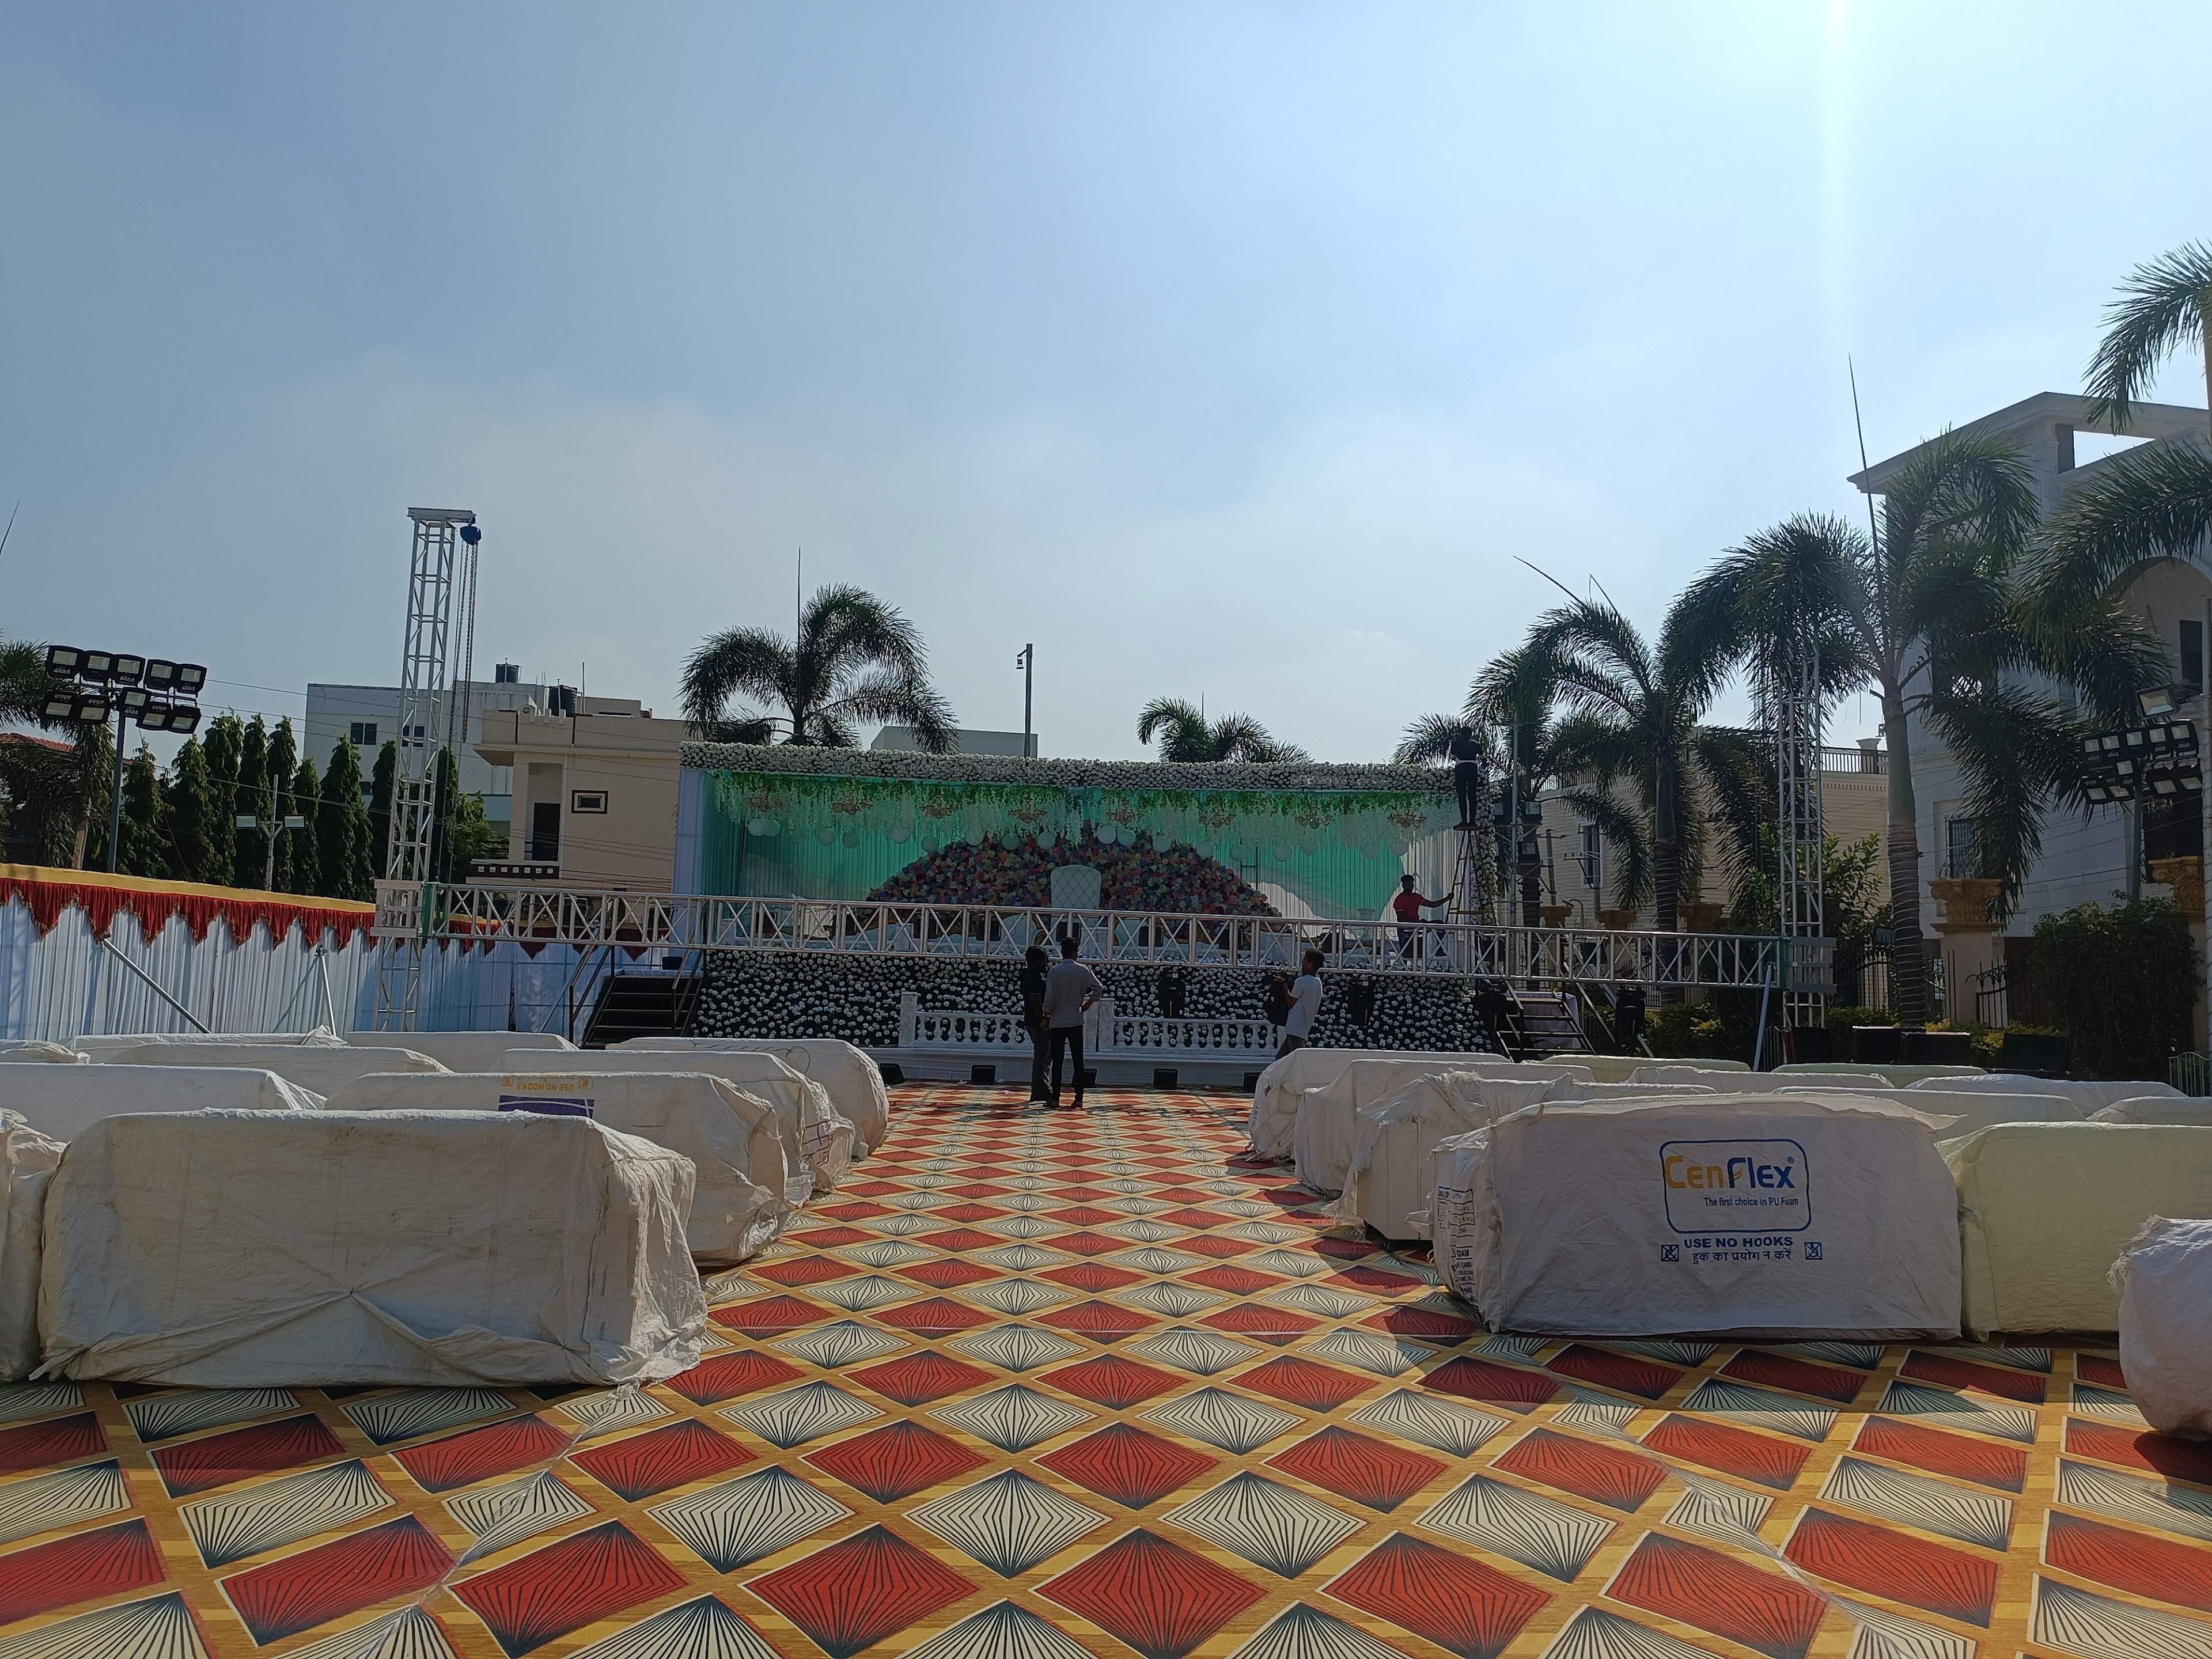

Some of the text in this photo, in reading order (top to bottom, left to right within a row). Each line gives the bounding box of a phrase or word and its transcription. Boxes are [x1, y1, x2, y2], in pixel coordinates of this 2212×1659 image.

[517, 1082, 544, 1090] HOOKS
[546, 1083, 557, 1091] NO
[1704, 1197, 1798, 1206] The first choice in PU Foam
[1684, 1237, 1793, 1248] USE NO HOOKS
[1691, 1247, 1791, 1264] हुक का प्रयोग न करें
